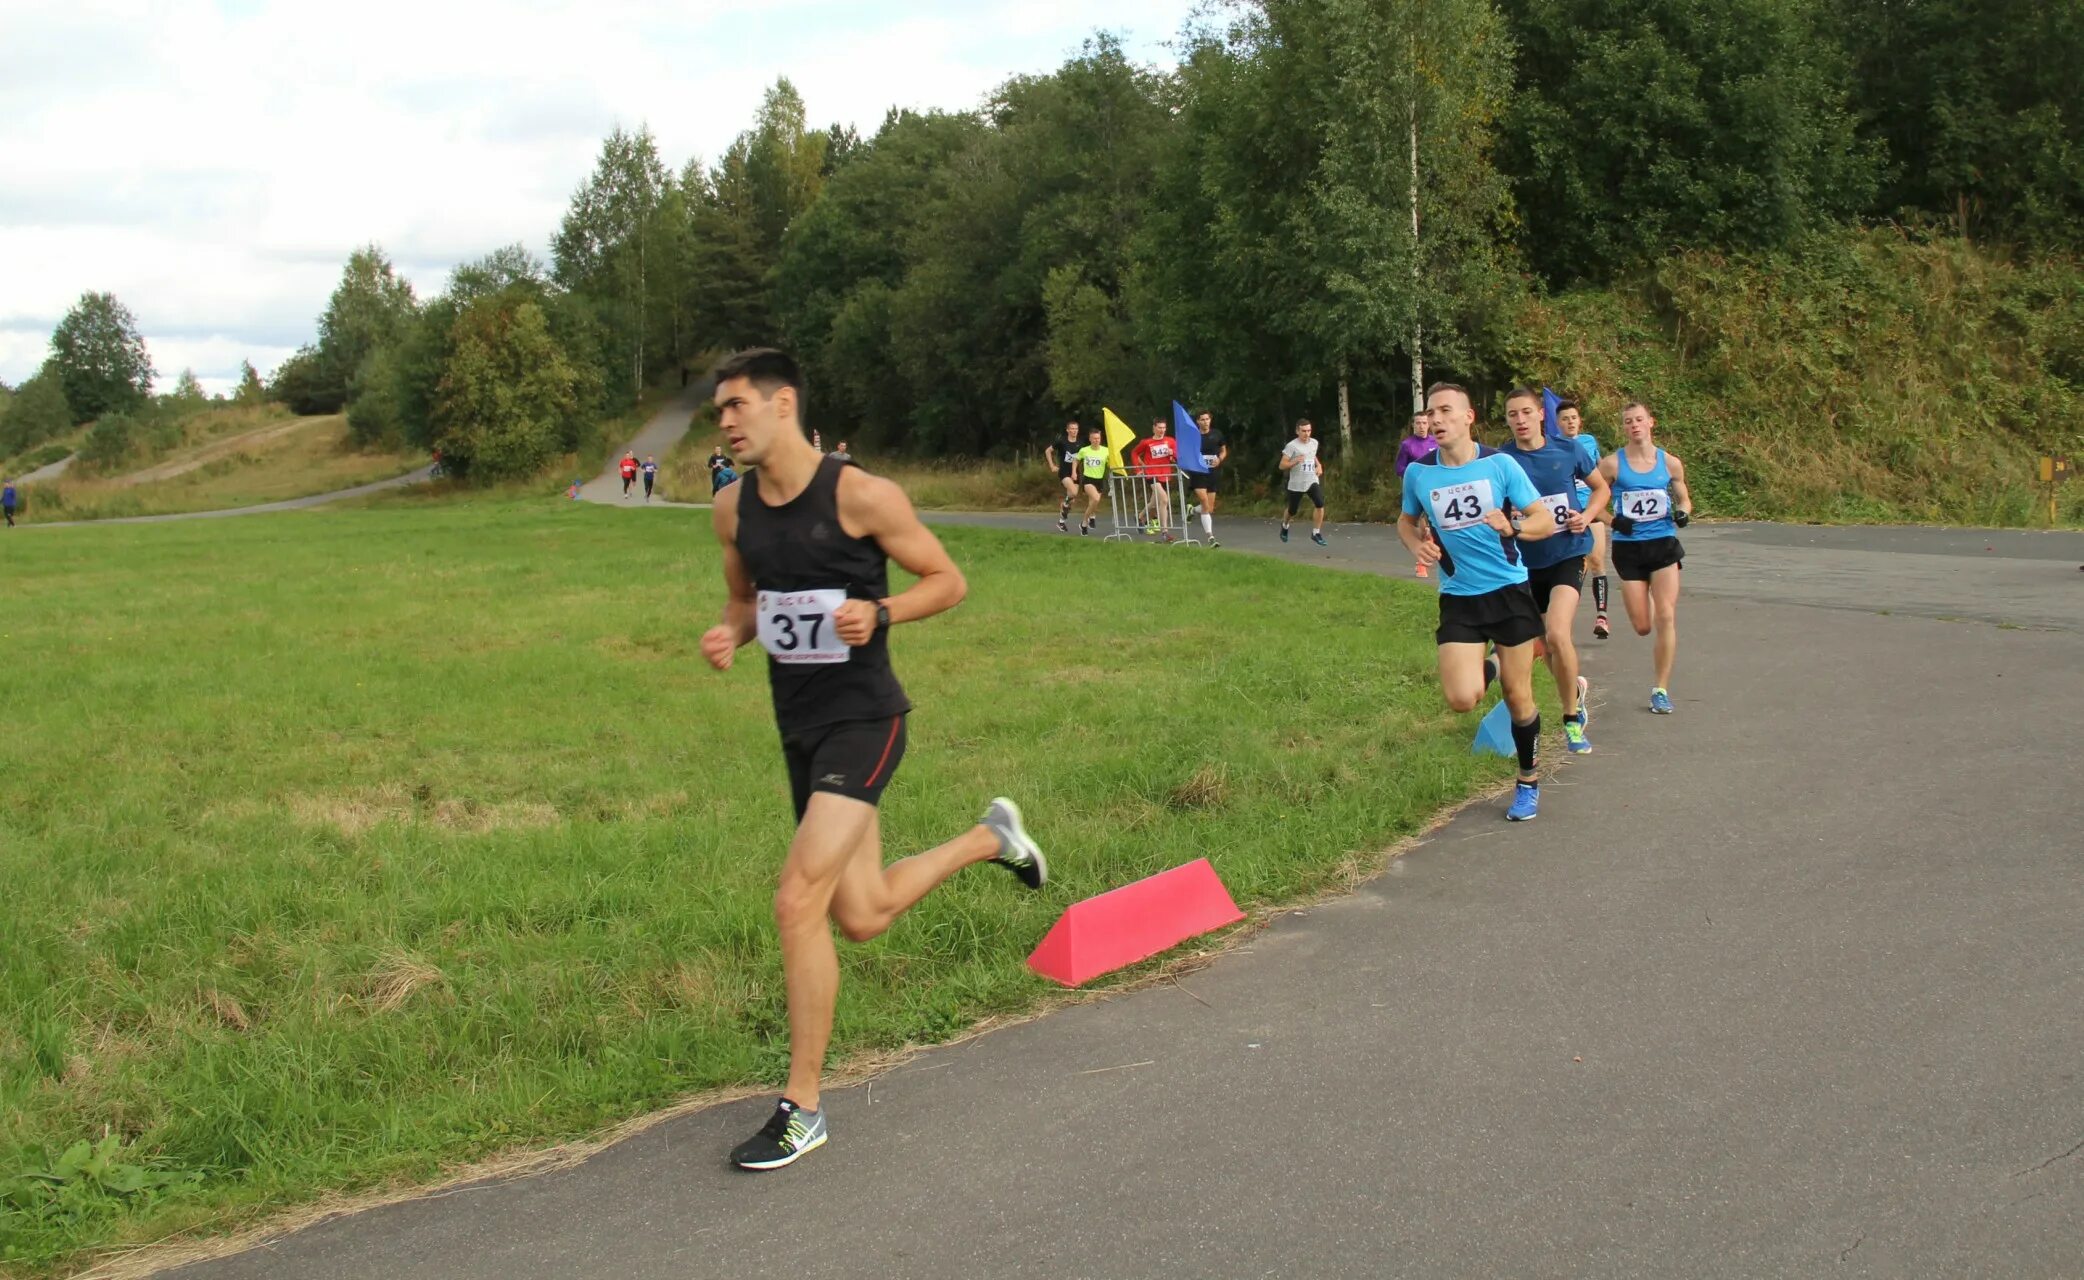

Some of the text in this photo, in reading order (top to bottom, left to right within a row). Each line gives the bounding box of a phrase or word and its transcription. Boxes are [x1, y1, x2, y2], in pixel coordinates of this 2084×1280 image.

[1152, 448, 1169, 456] 342
[1448, 485, 1474, 494] ЦСКА
[1444, 495, 1482, 521] 43
[1631, 498, 1658, 516] 42
[771, 613, 824, 650] 37
